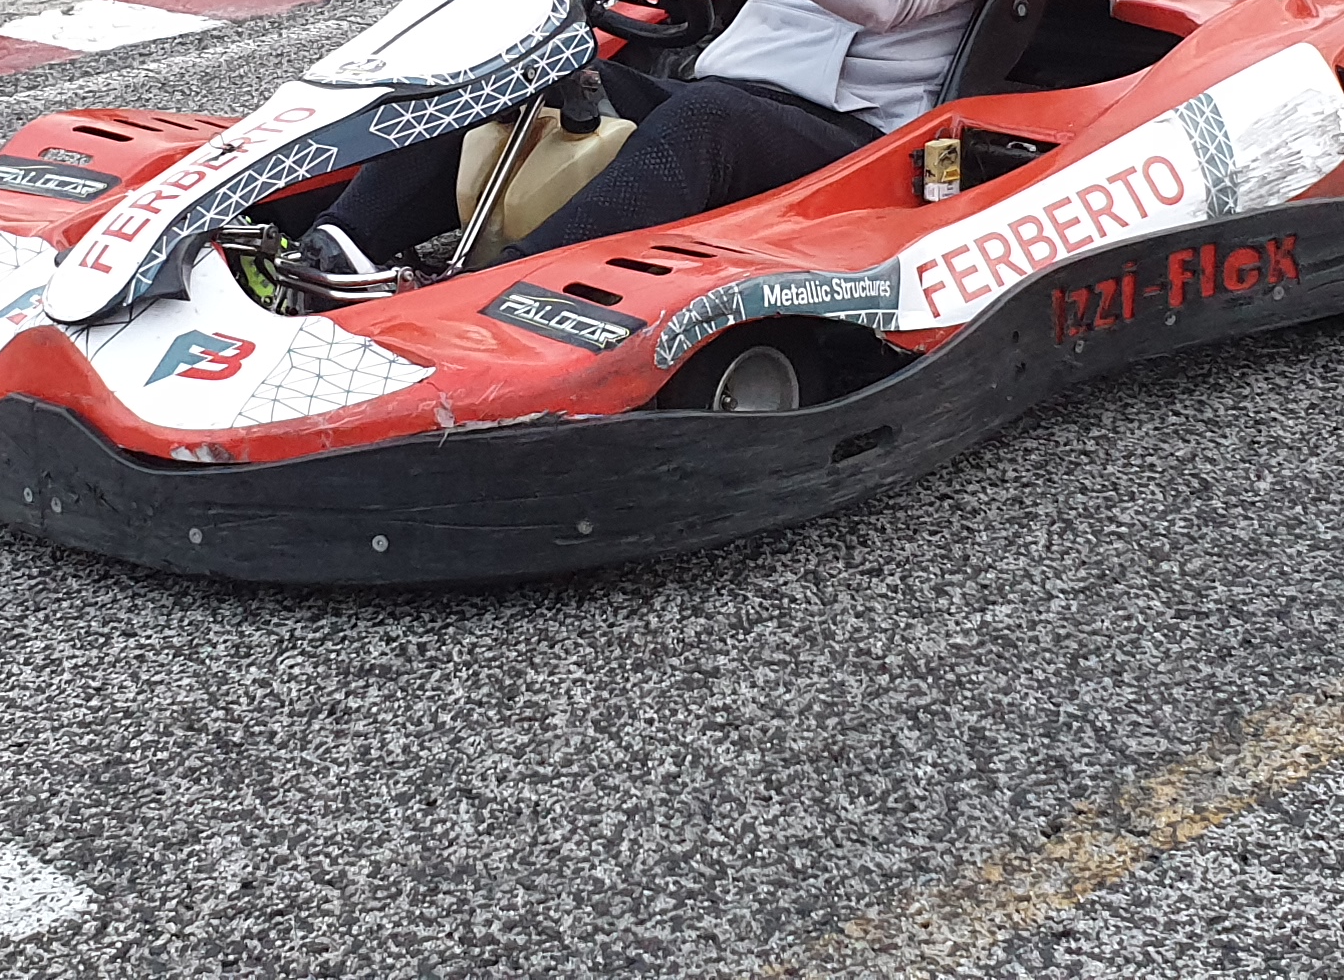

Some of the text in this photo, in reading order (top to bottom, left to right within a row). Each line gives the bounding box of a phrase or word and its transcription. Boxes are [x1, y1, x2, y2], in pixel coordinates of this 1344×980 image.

[77, 106, 319, 275] FERBERTO
[916, 155, 1185, 319] FERBERTO
[499, 294, 630, 348] PALOCAR
[762, 274, 892, 308] Metallic Structures
